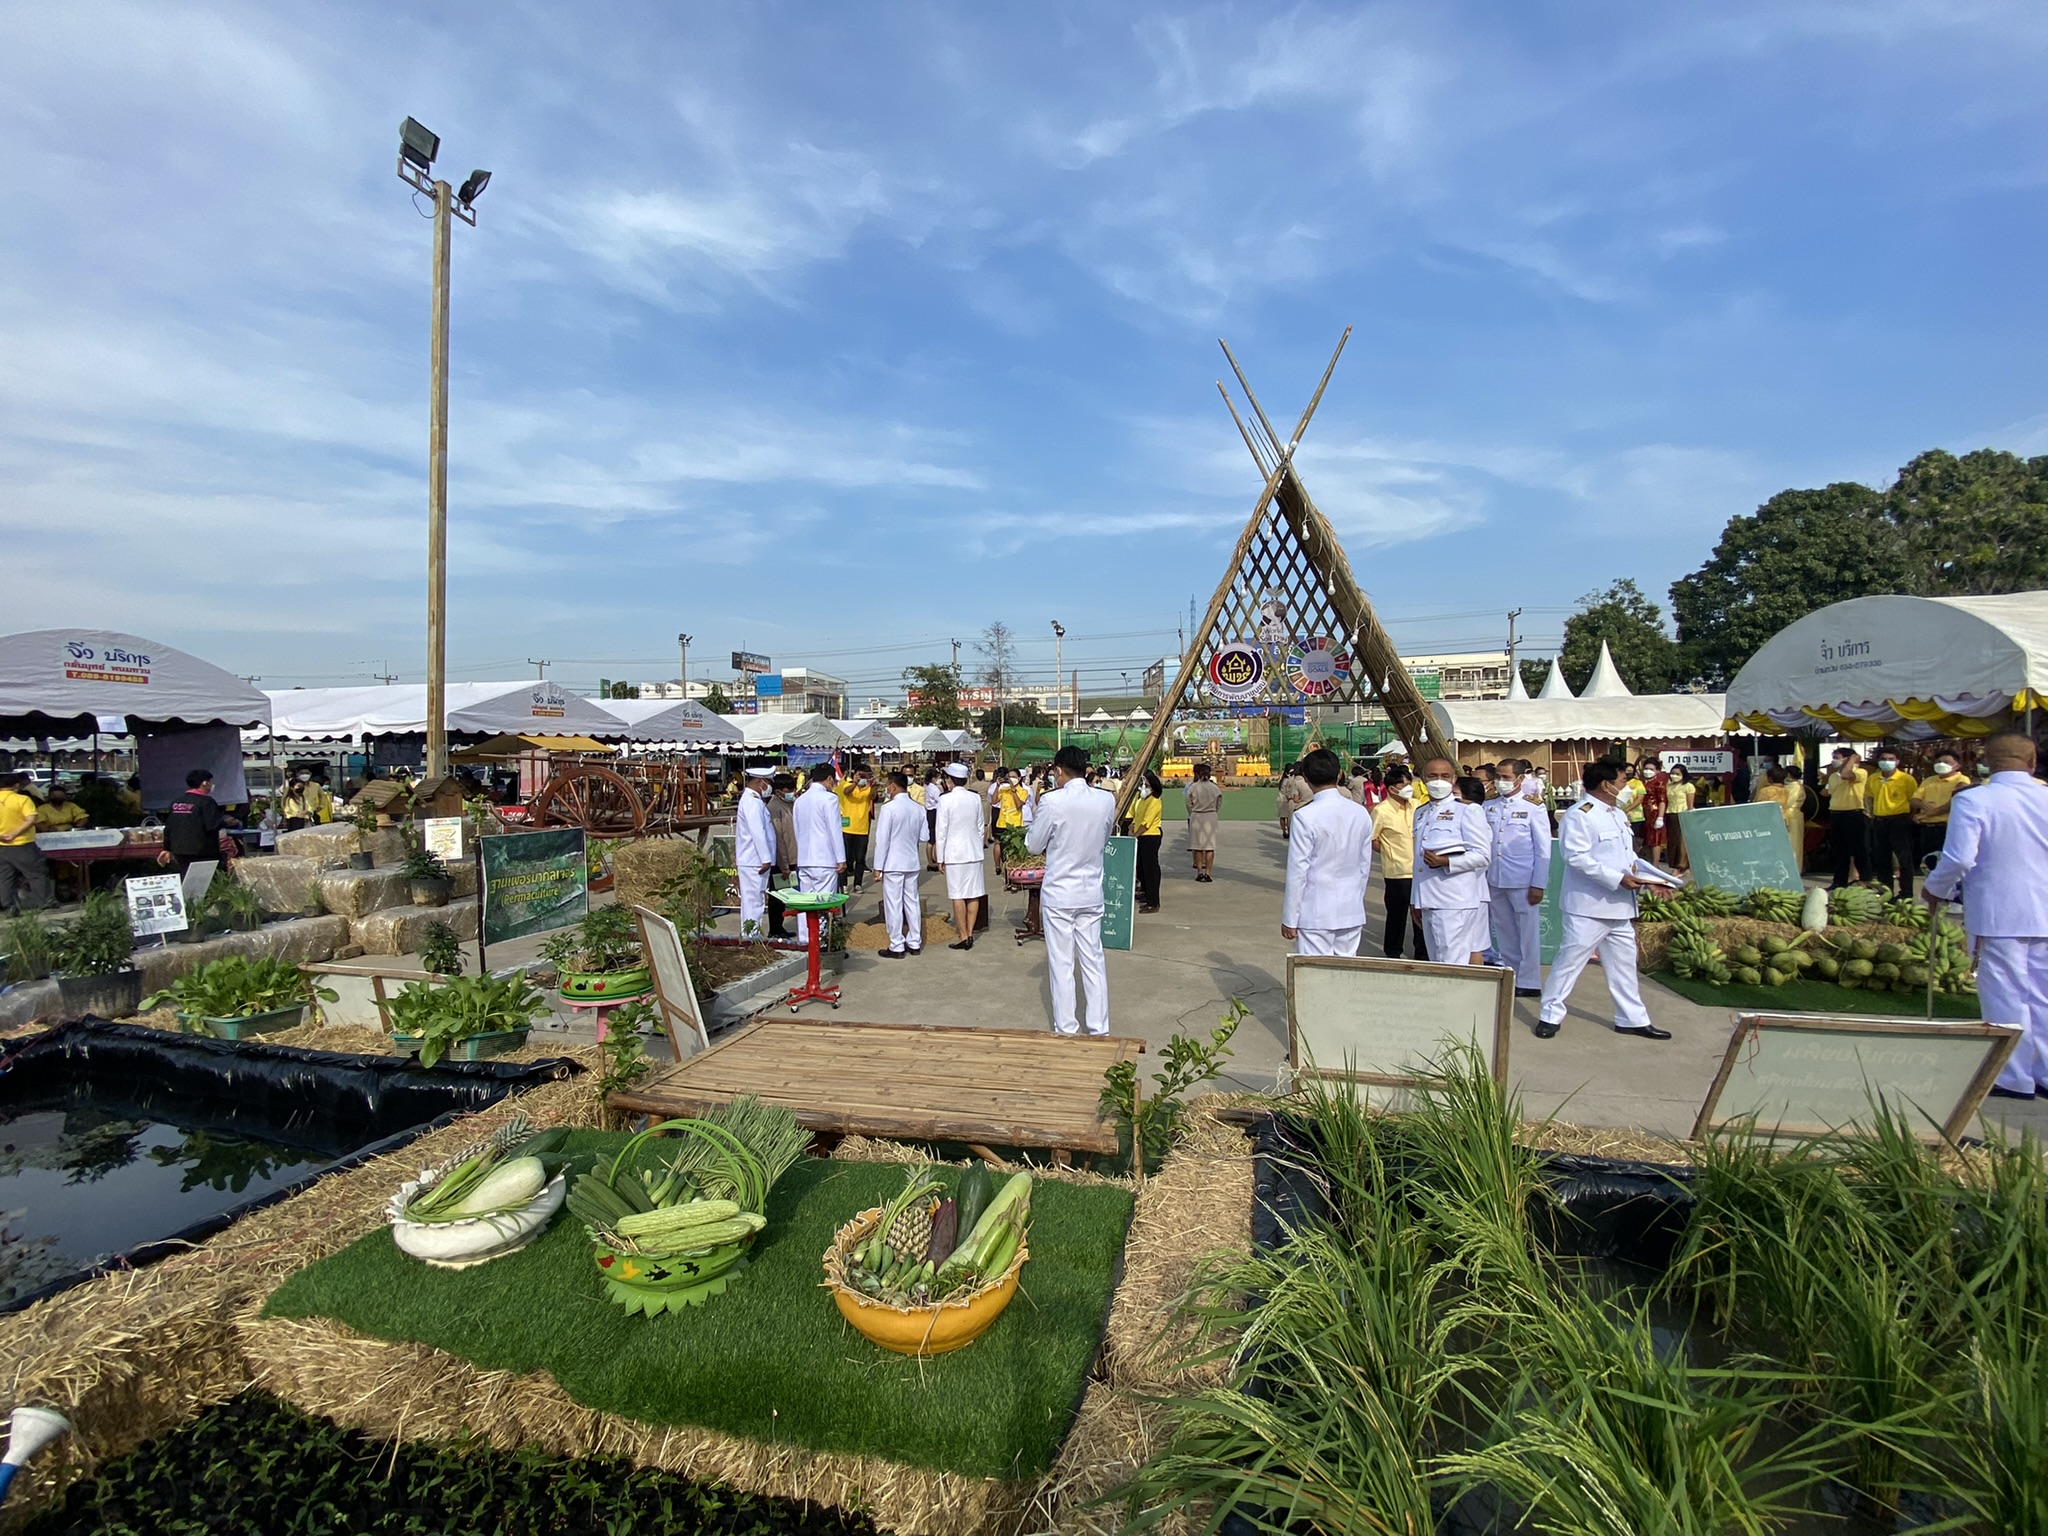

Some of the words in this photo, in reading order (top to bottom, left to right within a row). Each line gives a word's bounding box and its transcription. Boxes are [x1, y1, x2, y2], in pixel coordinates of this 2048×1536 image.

[1274, 635, 1288, 643] Day
[1838, 639, 1870, 658] บริการ
[104, 648, 151, 668] บริการ
[1668, 753, 1723, 766] กาญจนบุรี
